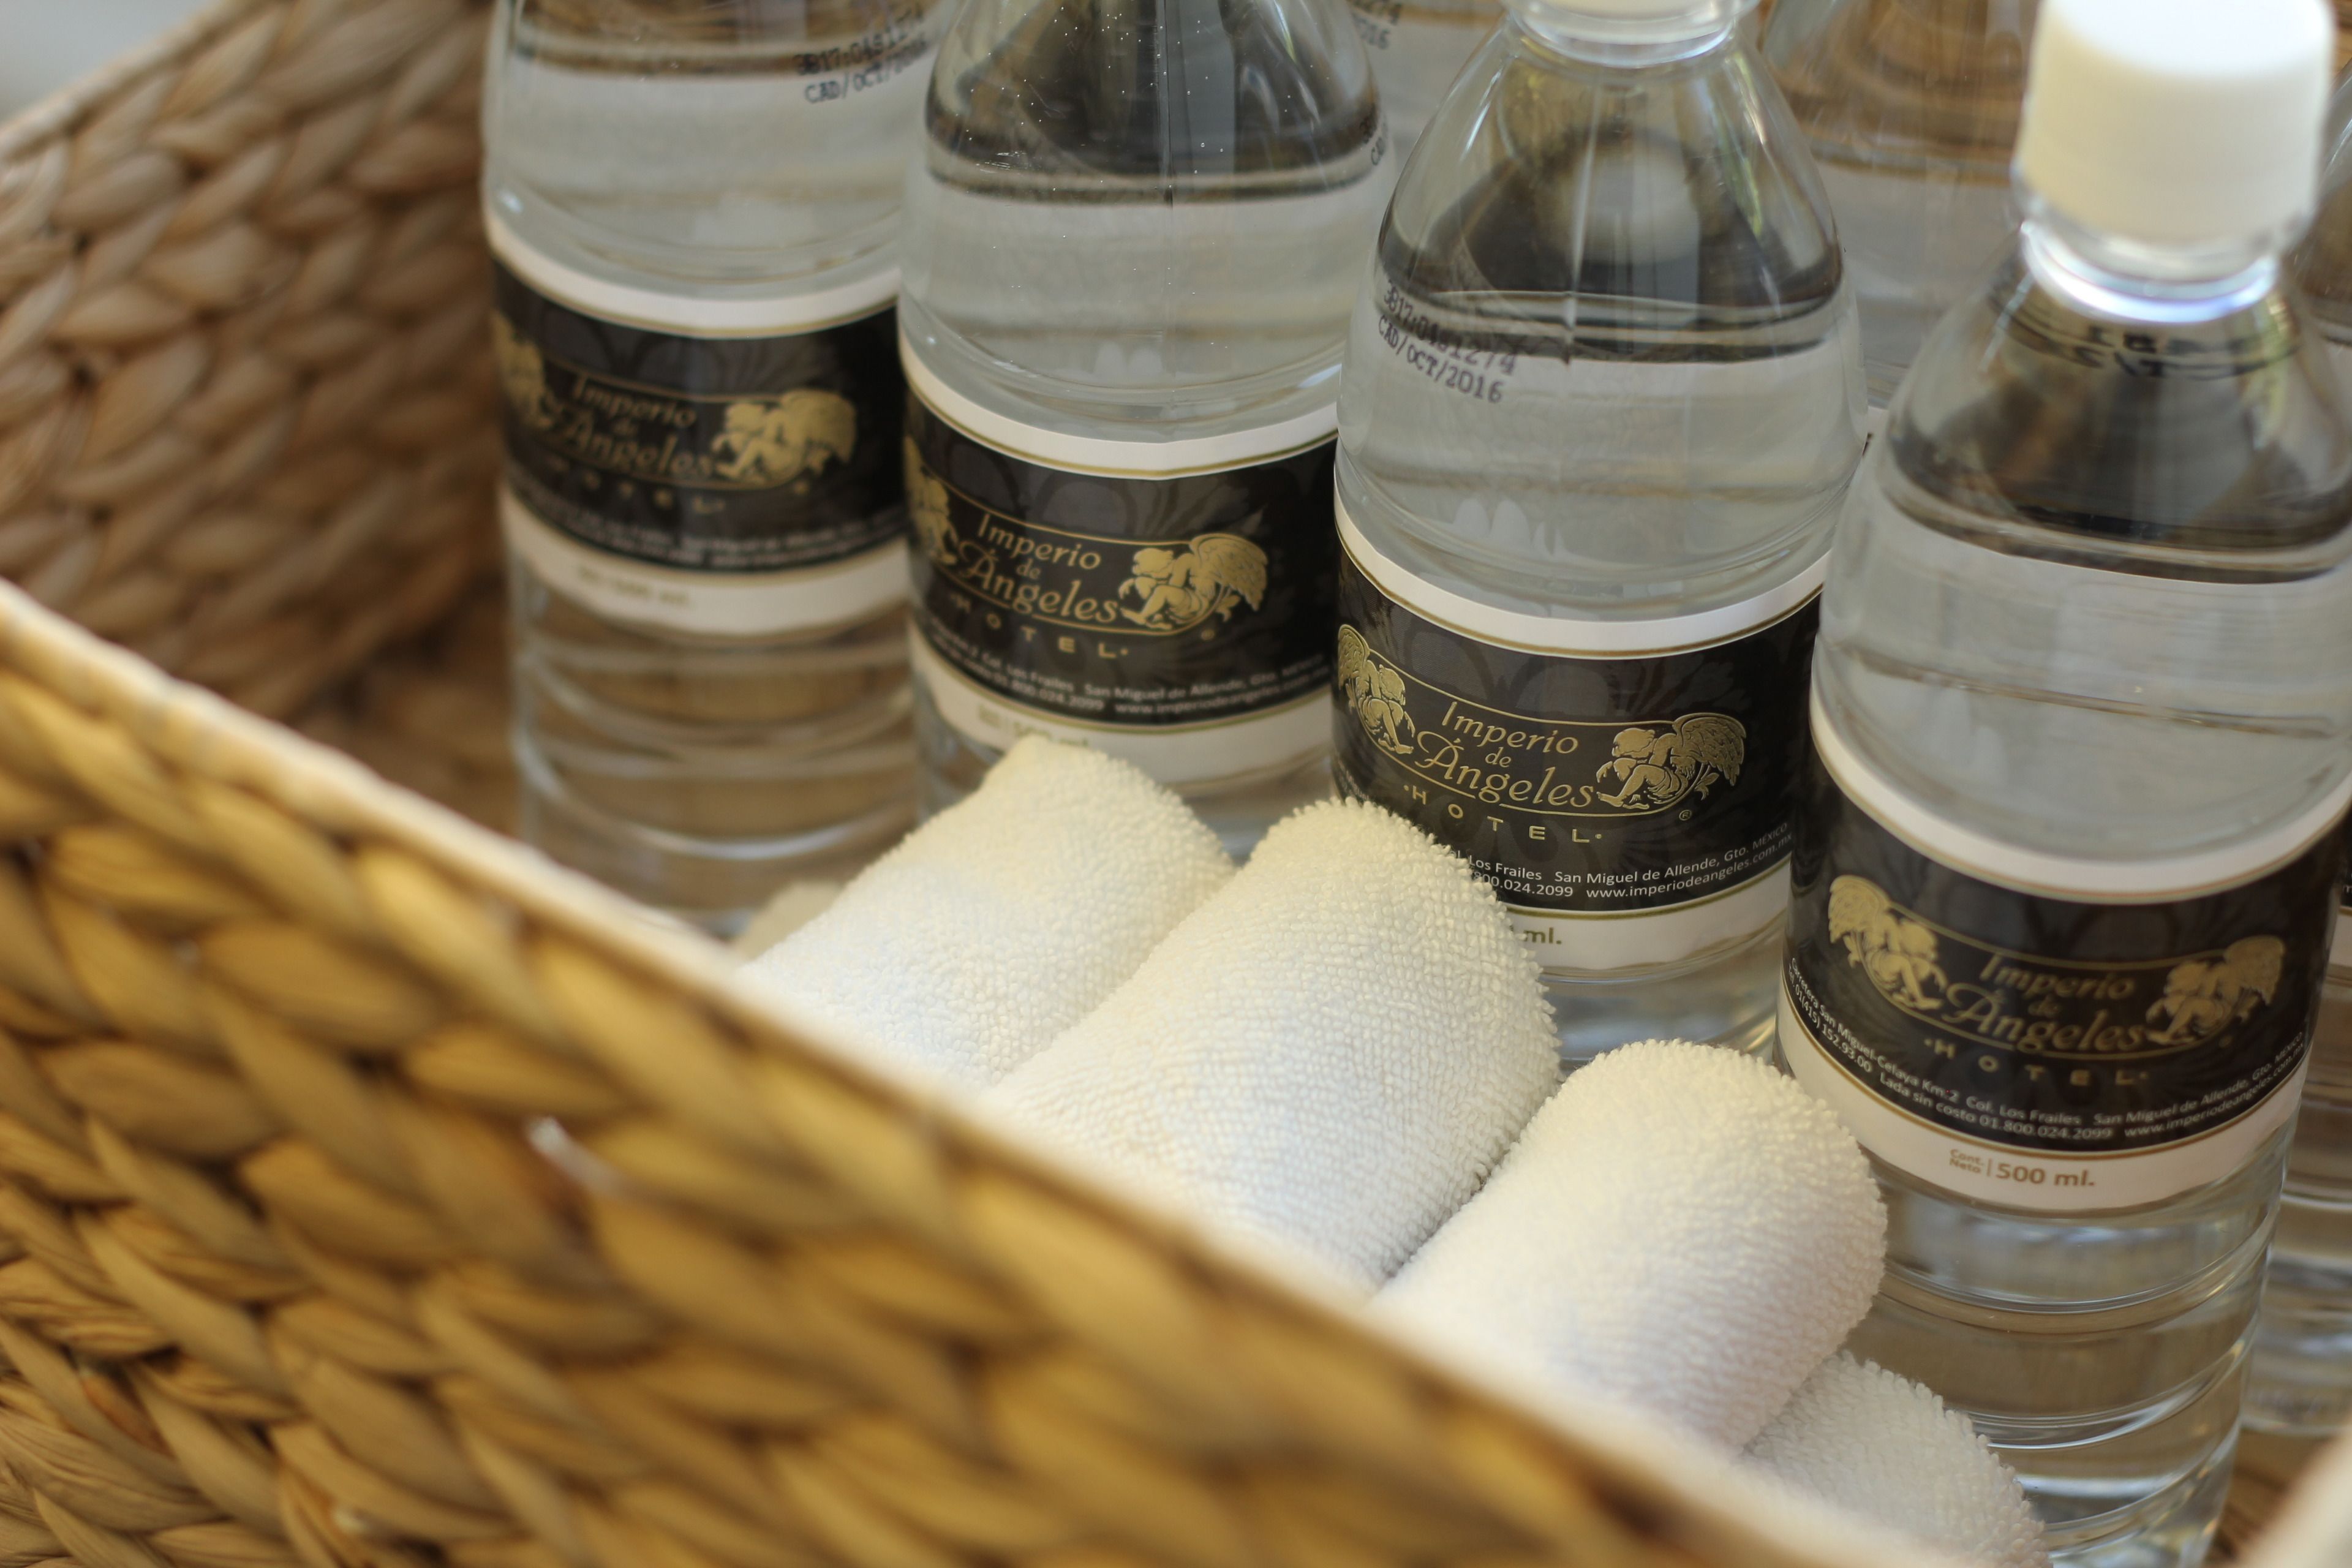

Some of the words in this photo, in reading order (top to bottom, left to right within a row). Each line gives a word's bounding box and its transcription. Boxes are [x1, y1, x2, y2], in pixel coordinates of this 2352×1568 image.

[1379, 314, 1504, 404] CAD/OCT/2016
[978, 513, 1101, 570] Imperio
[1016, 558, 1041, 579] de
[1084, 682, 1111, 698] San
[1441, 701, 1578, 755] Imperio
[1414, 731, 1594, 808] Ángeles
[1484, 747, 1512, 767] de
[1469, 854, 1491, 870] Los
[1495, 862, 1542, 880] Frailes
[1554, 870, 1581, 883] San
[1586, 872, 1638, 886] Miguel
[1642, 869, 1660, 881] de
[1664, 857, 1720, 879] Allende,
[1724, 846, 1749, 862] Gto.
[1752, 822, 1788, 850] MÉXICO
[1473, 871, 1574, 897] 800.024.2099
[1586, 832, 1793, 898] www.imperiodeangeles.com.mx
[1523, 926, 1562, 944] ml.
[1978, 952, 2136, 1000] Imperio
[2027, 993, 2062, 1018] de
[1792, 957, 1819, 1009] Carretera
[1819, 1004, 1836, 1028] San
[1999, 1104, 2026, 1120] Los
[2029, 1109, 2081, 1126] Frailes
[2094, 1112, 2122, 1126] San
[2125, 1104, 2177, 1125] Miguel
[2179, 1099, 2197, 1113] de
[2199, 1079, 2249, 1105] Allende,
[1822, 1023, 1872, 1073] 152.93.00
[1880, 1072, 1911, 1098] Lada
[1912, 1091, 1934, 1108] sin
[1936, 1102, 1978, 1123] costo
[1978, 1114, 2114, 1140] 01.800.024.2099
[1996, 1163, 2046, 1185] 500
[2054, 1169, 2097, 1186] ml.
